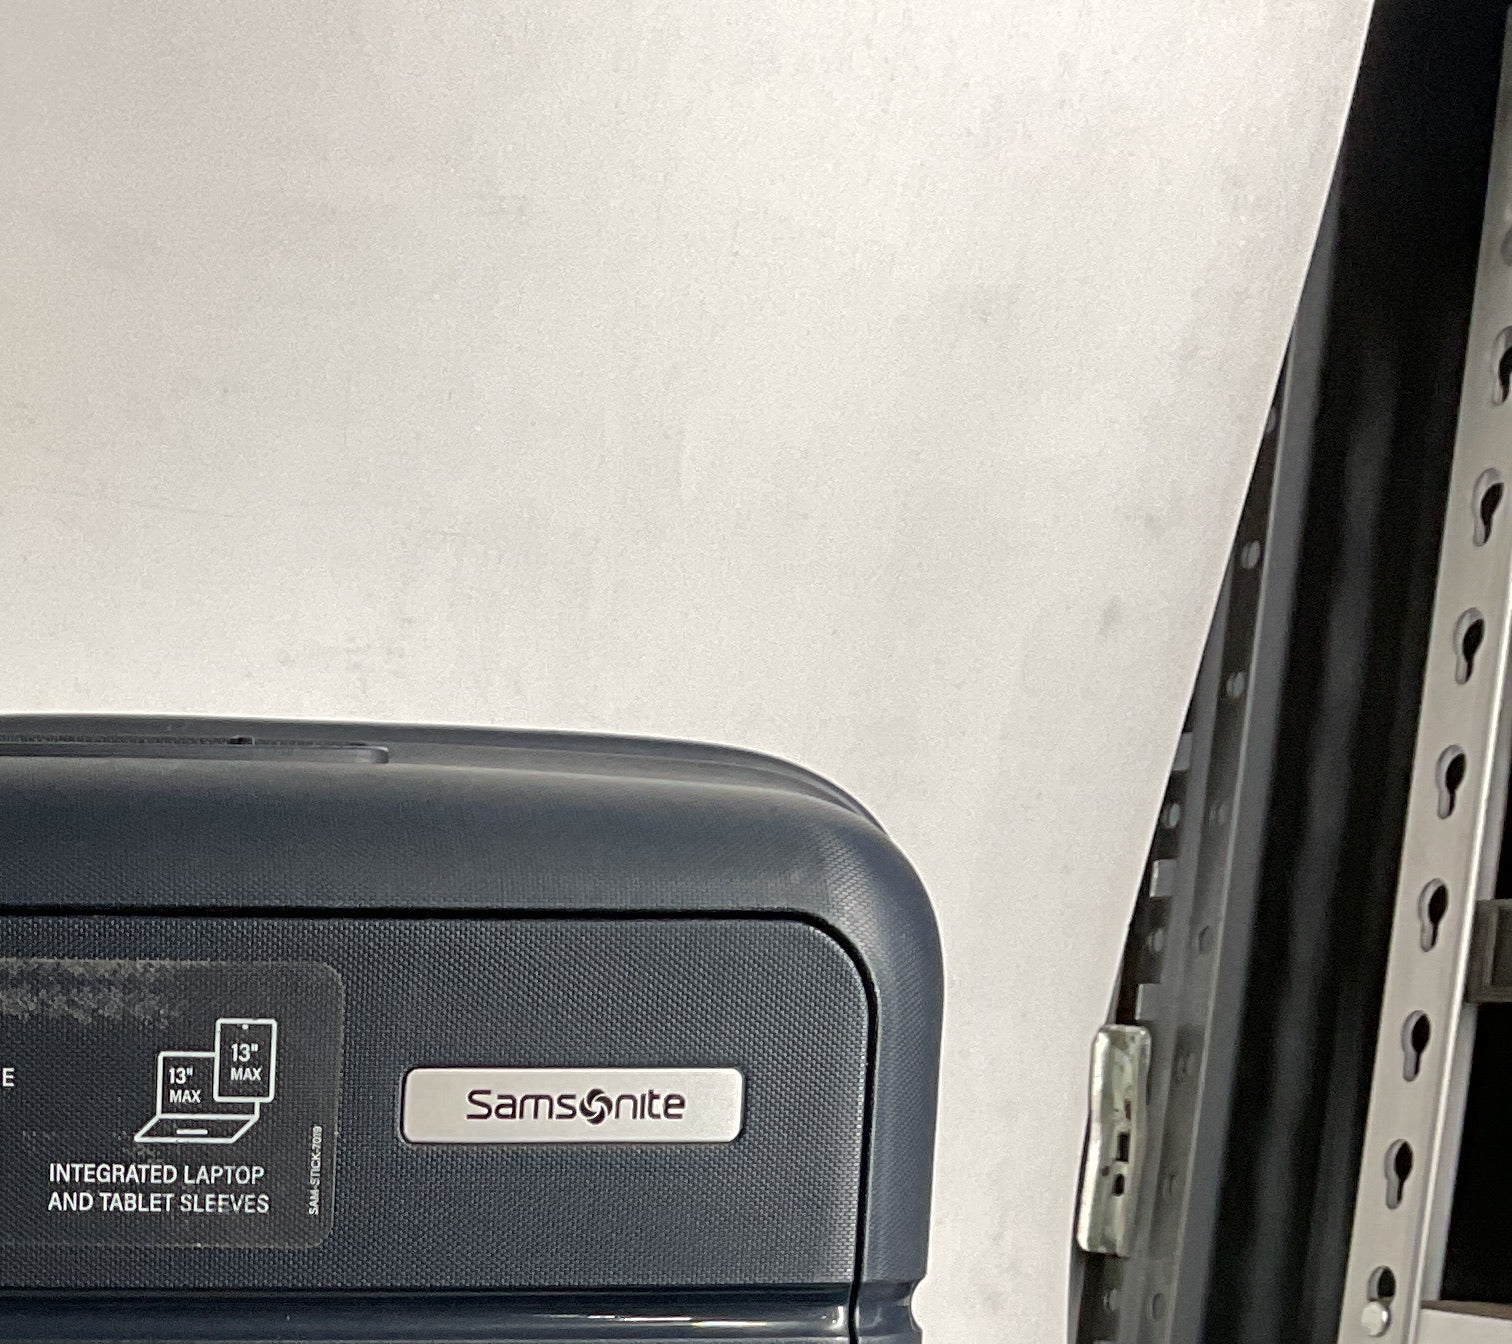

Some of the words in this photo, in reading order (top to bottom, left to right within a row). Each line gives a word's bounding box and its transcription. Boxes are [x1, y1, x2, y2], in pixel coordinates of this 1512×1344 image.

[230, 1067, 263, 1081] MAX
[169, 1089, 201, 1103] MAX
[466, 1088, 686, 1125] Samsonite
[49, 1163, 178, 1184] INTEGRATED
[184, 1165, 265, 1185] LAPTOP
[48, 1191, 93, 1211] AND
[99, 1192, 175, 1213] TABLET
[180, 1193, 270, 1214] SLEEVES
